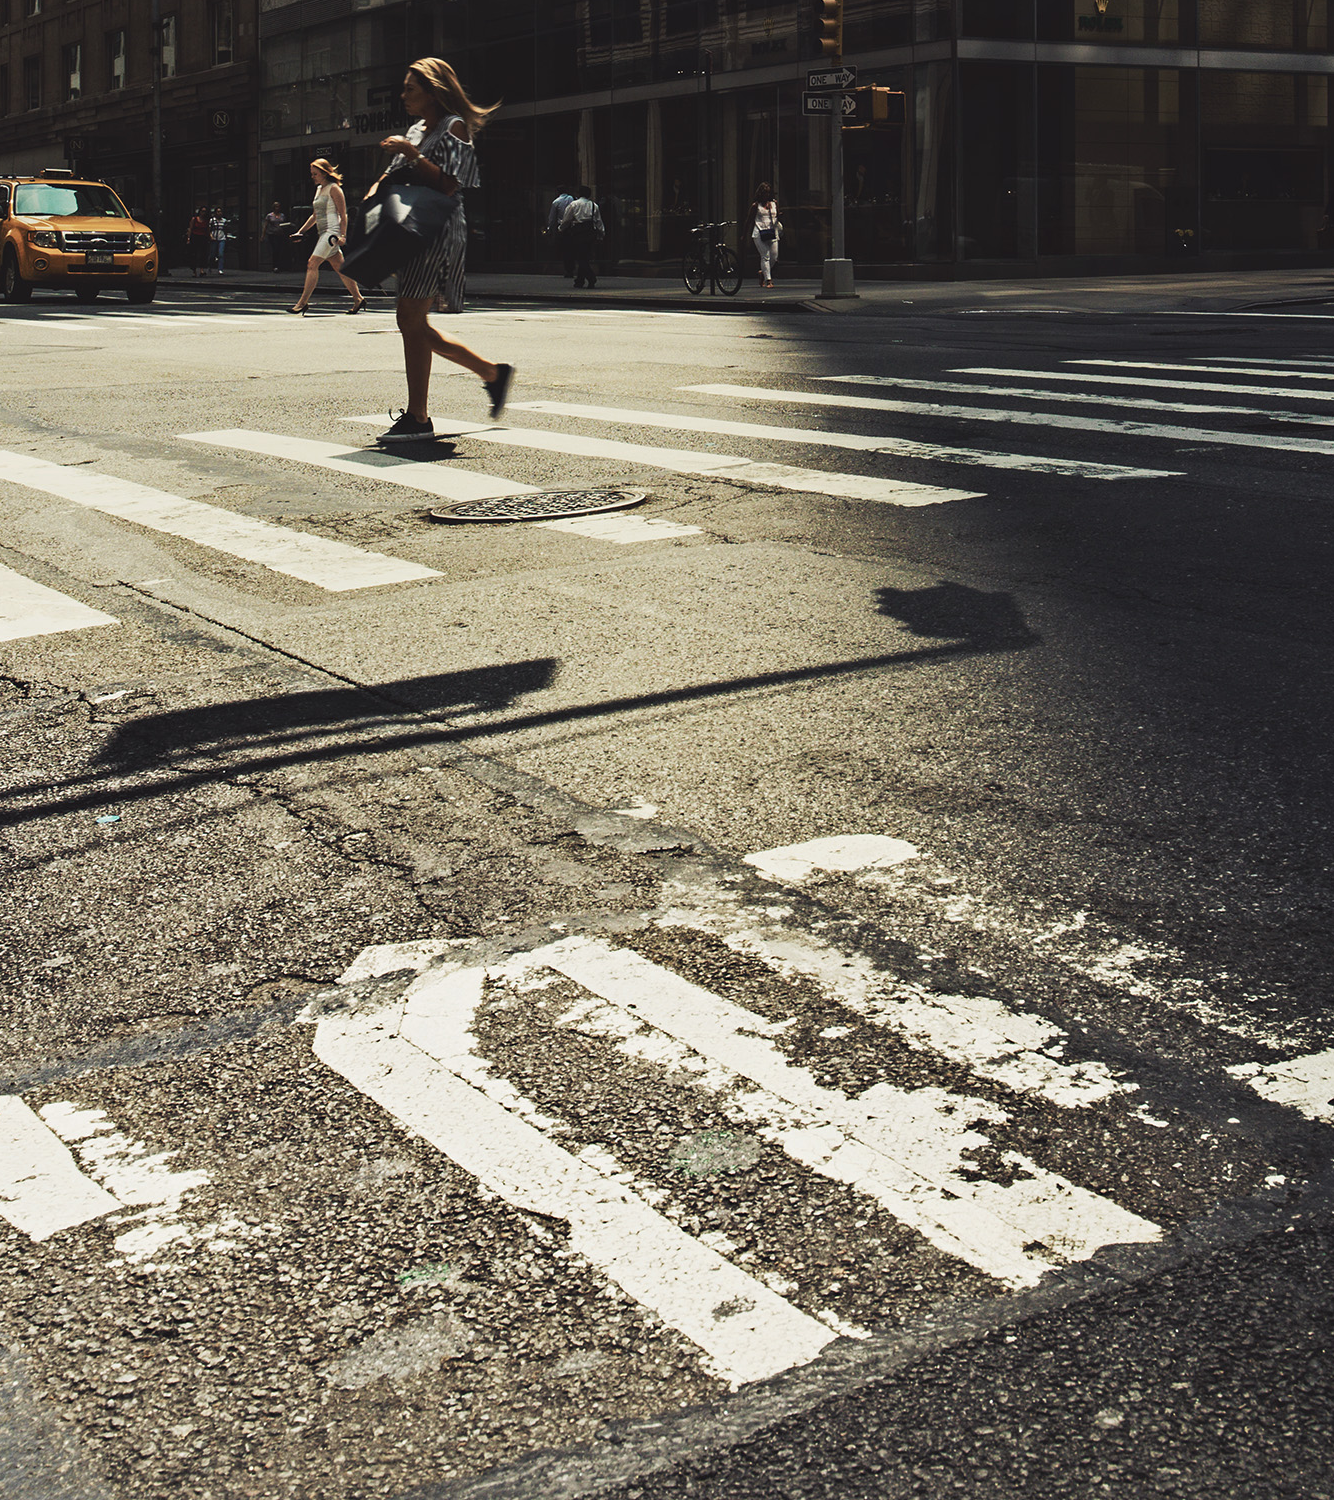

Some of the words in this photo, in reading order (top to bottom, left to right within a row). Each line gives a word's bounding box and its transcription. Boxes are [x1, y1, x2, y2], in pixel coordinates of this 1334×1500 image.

[811, 77, 827, 86] ONE
[835, 73, 851, 84] WAY
[812, 99, 829, 109] ONE
[841, 100, 853, 110] AY
